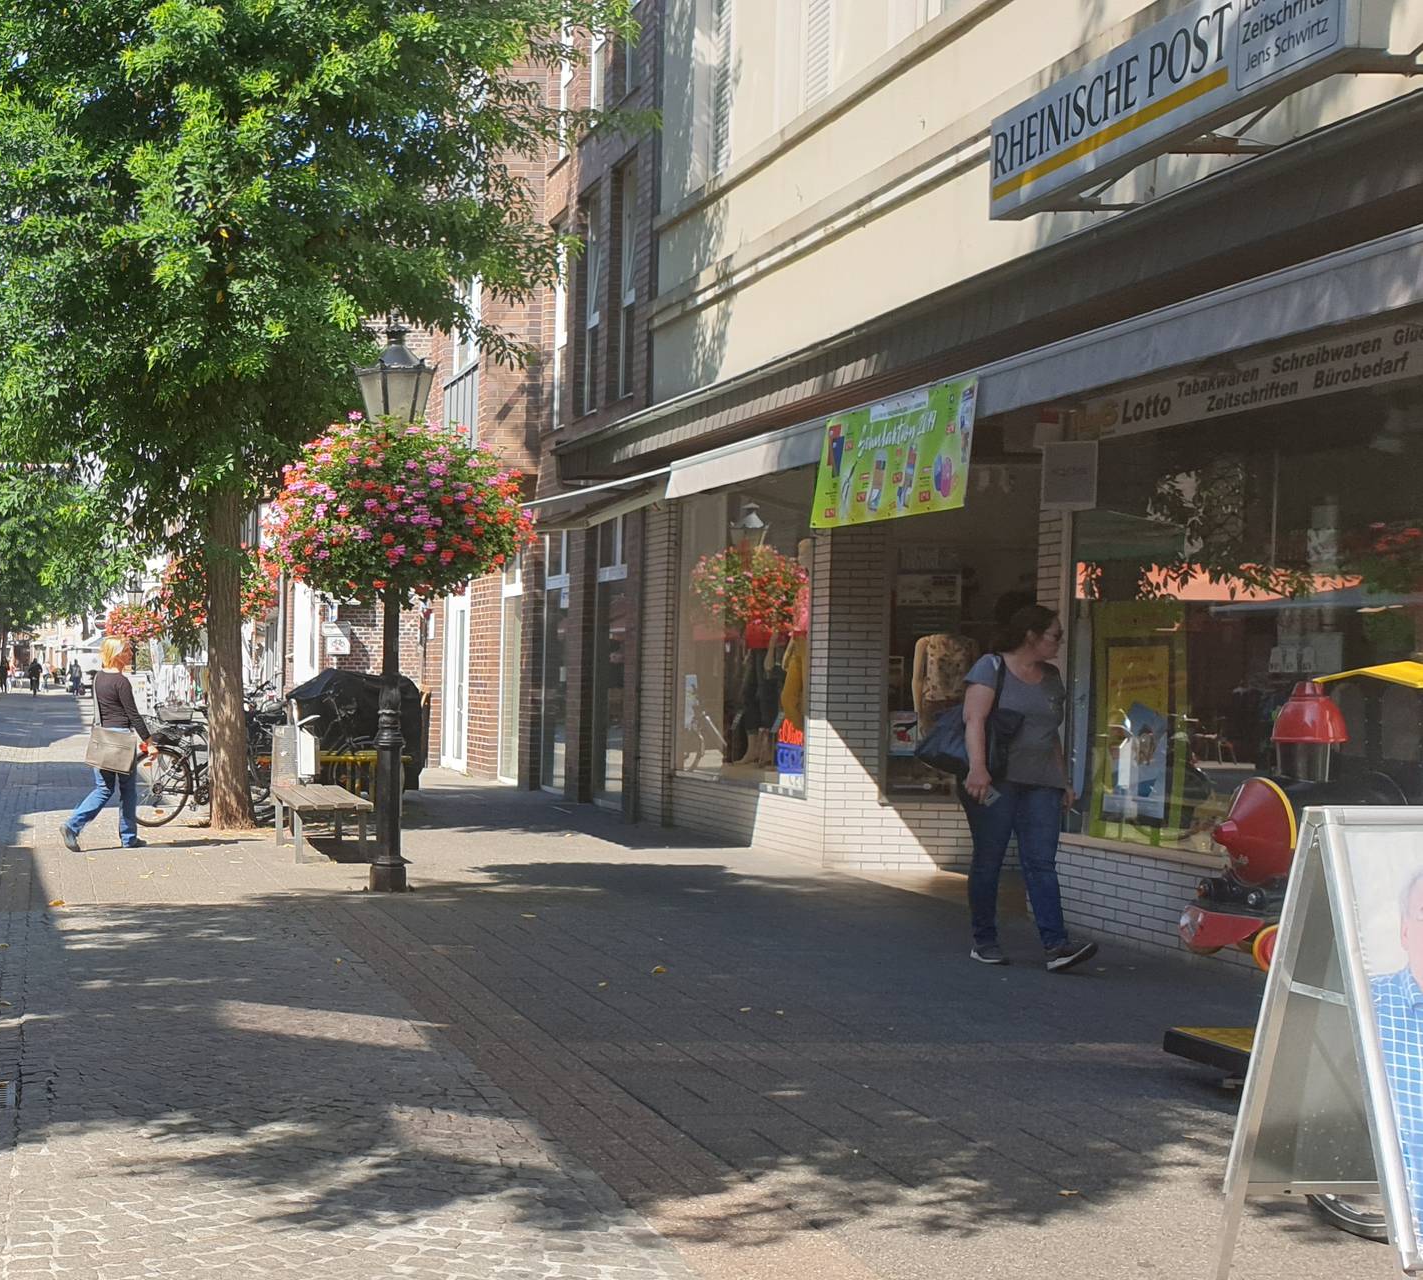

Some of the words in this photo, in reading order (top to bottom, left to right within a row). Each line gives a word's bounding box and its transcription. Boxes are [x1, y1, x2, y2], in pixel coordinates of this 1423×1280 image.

[1245, 44, 1271, 72] Jens
[1274, 17, 1330, 53] Schwirtz
[993, 54, 1139, 180] RHEINISCHE
[1147, 2, 1233, 98] POST
[1177, 365, 1260, 399] Tabakwaren
[1272, 336, 1382, 375] Schreibwaren
[1207, 379, 1299, 413] Zeitschriften
[1313, 351, 1409, 390] Bürobedarf
[1121, 392, 1171, 425] Lotto
